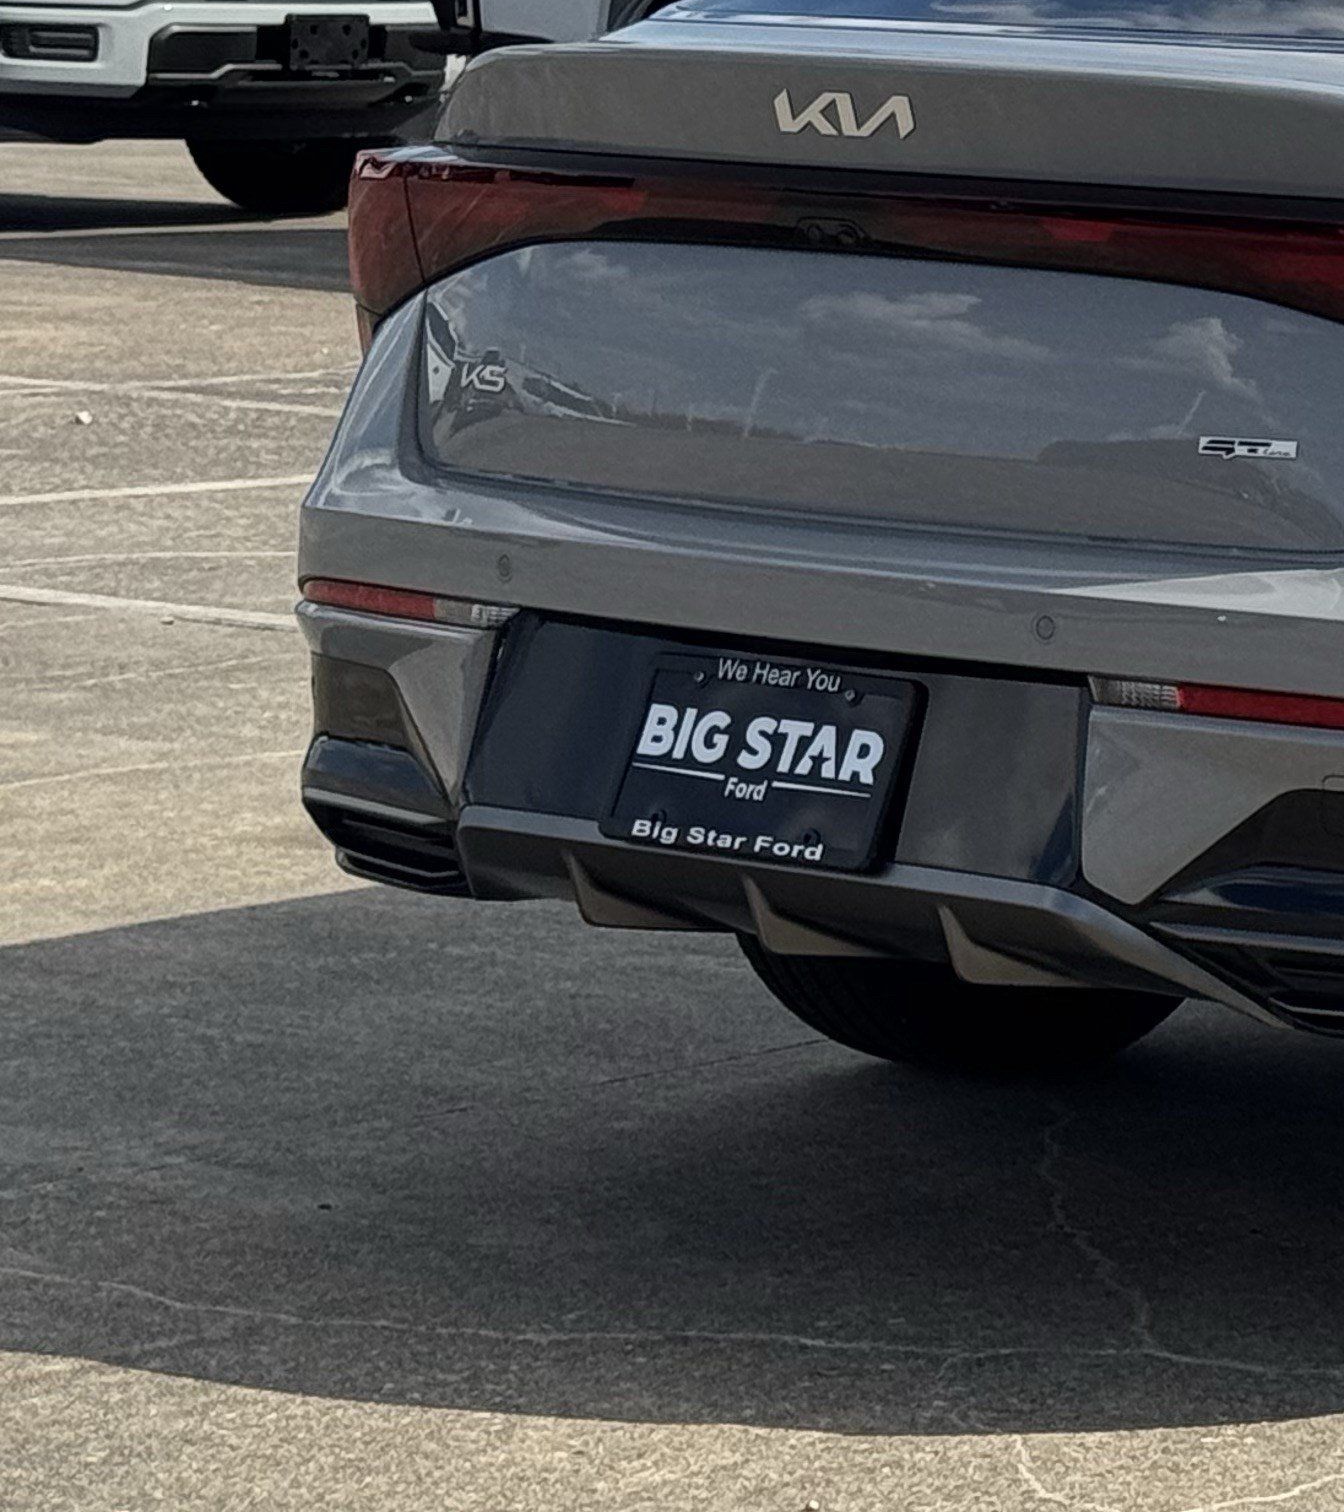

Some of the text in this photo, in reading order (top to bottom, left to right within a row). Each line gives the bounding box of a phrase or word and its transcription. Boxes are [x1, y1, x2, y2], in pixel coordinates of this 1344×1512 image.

[773, 88, 916, 139] KIA
[717, 657, 842, 693] We Hear You
[636, 703, 886, 786] BIG STAR
[724, 777, 768, 802] Ford
[631, 819, 824, 862] Big Star Ford
